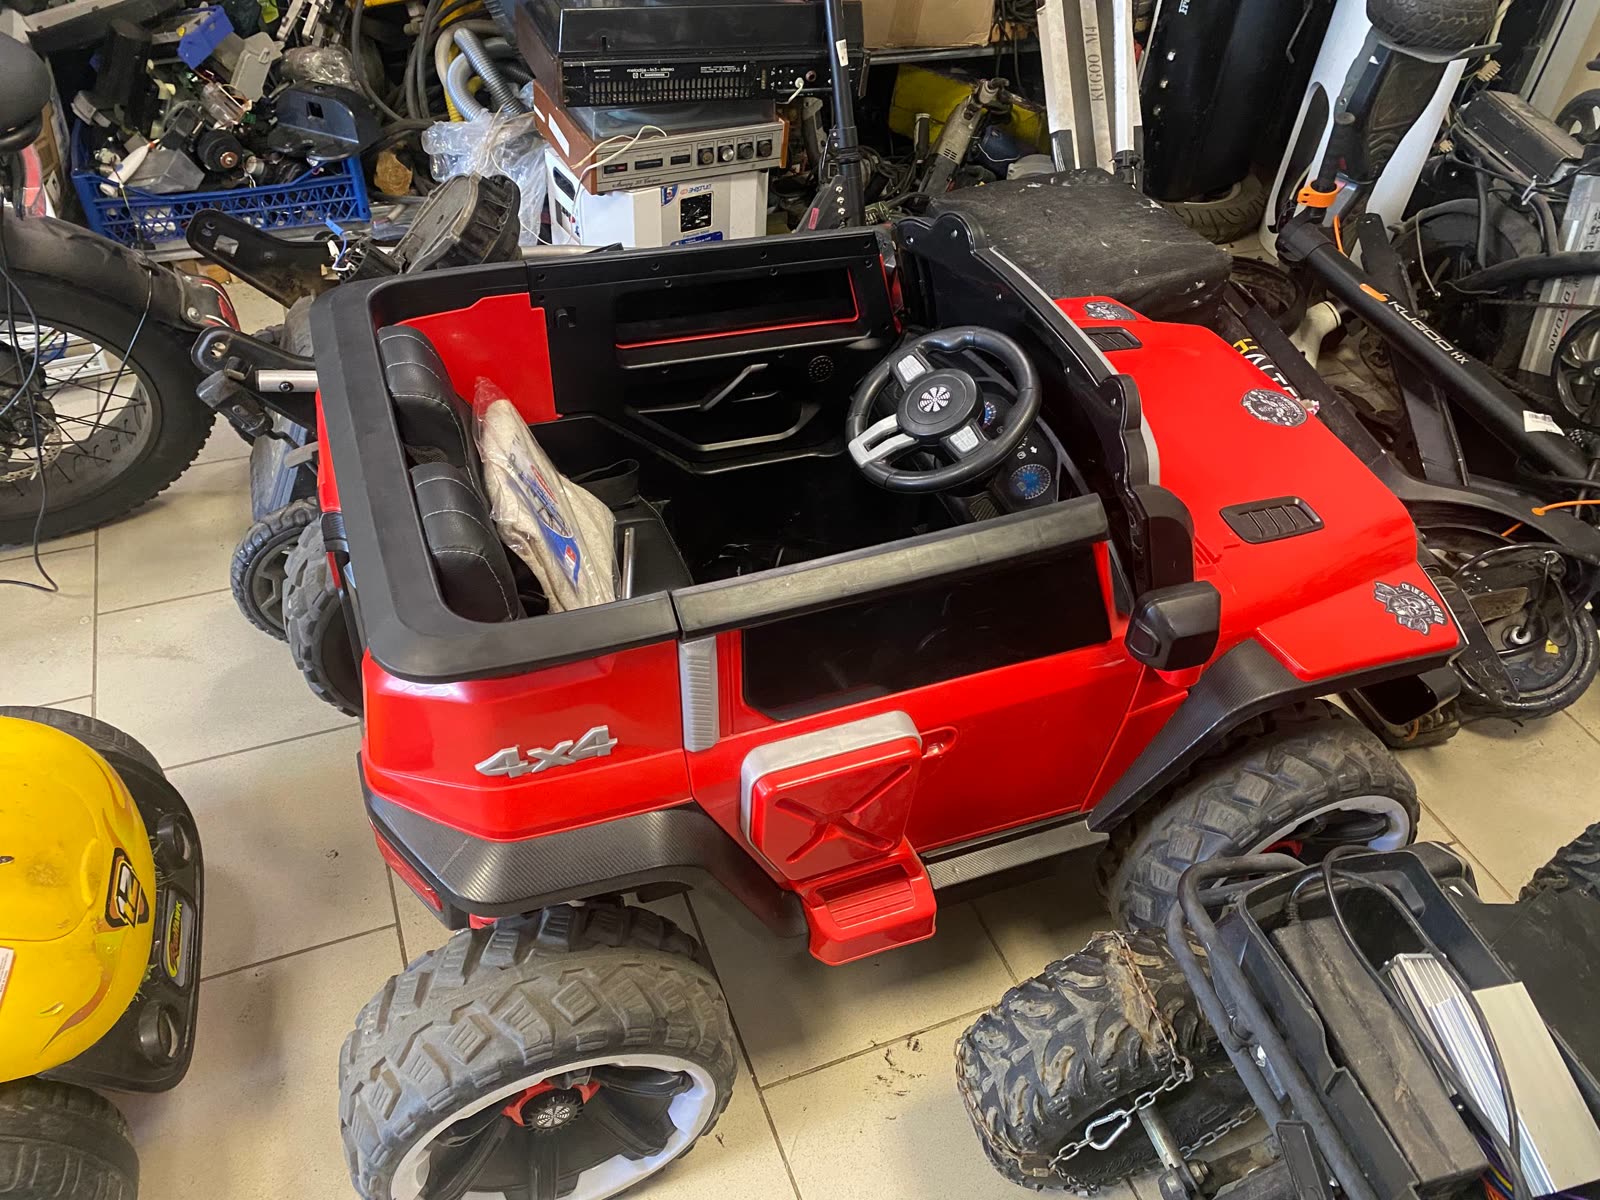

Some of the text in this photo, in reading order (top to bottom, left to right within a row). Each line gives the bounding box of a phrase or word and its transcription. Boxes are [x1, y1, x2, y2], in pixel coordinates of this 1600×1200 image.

[1085, 26, 1105, 102] KUGOO M4
[1388, 301, 1470, 365] KUGOO HX
[1550, 291, 1571, 351] DYUAN
[474, 724, 618, 778] 4x4
